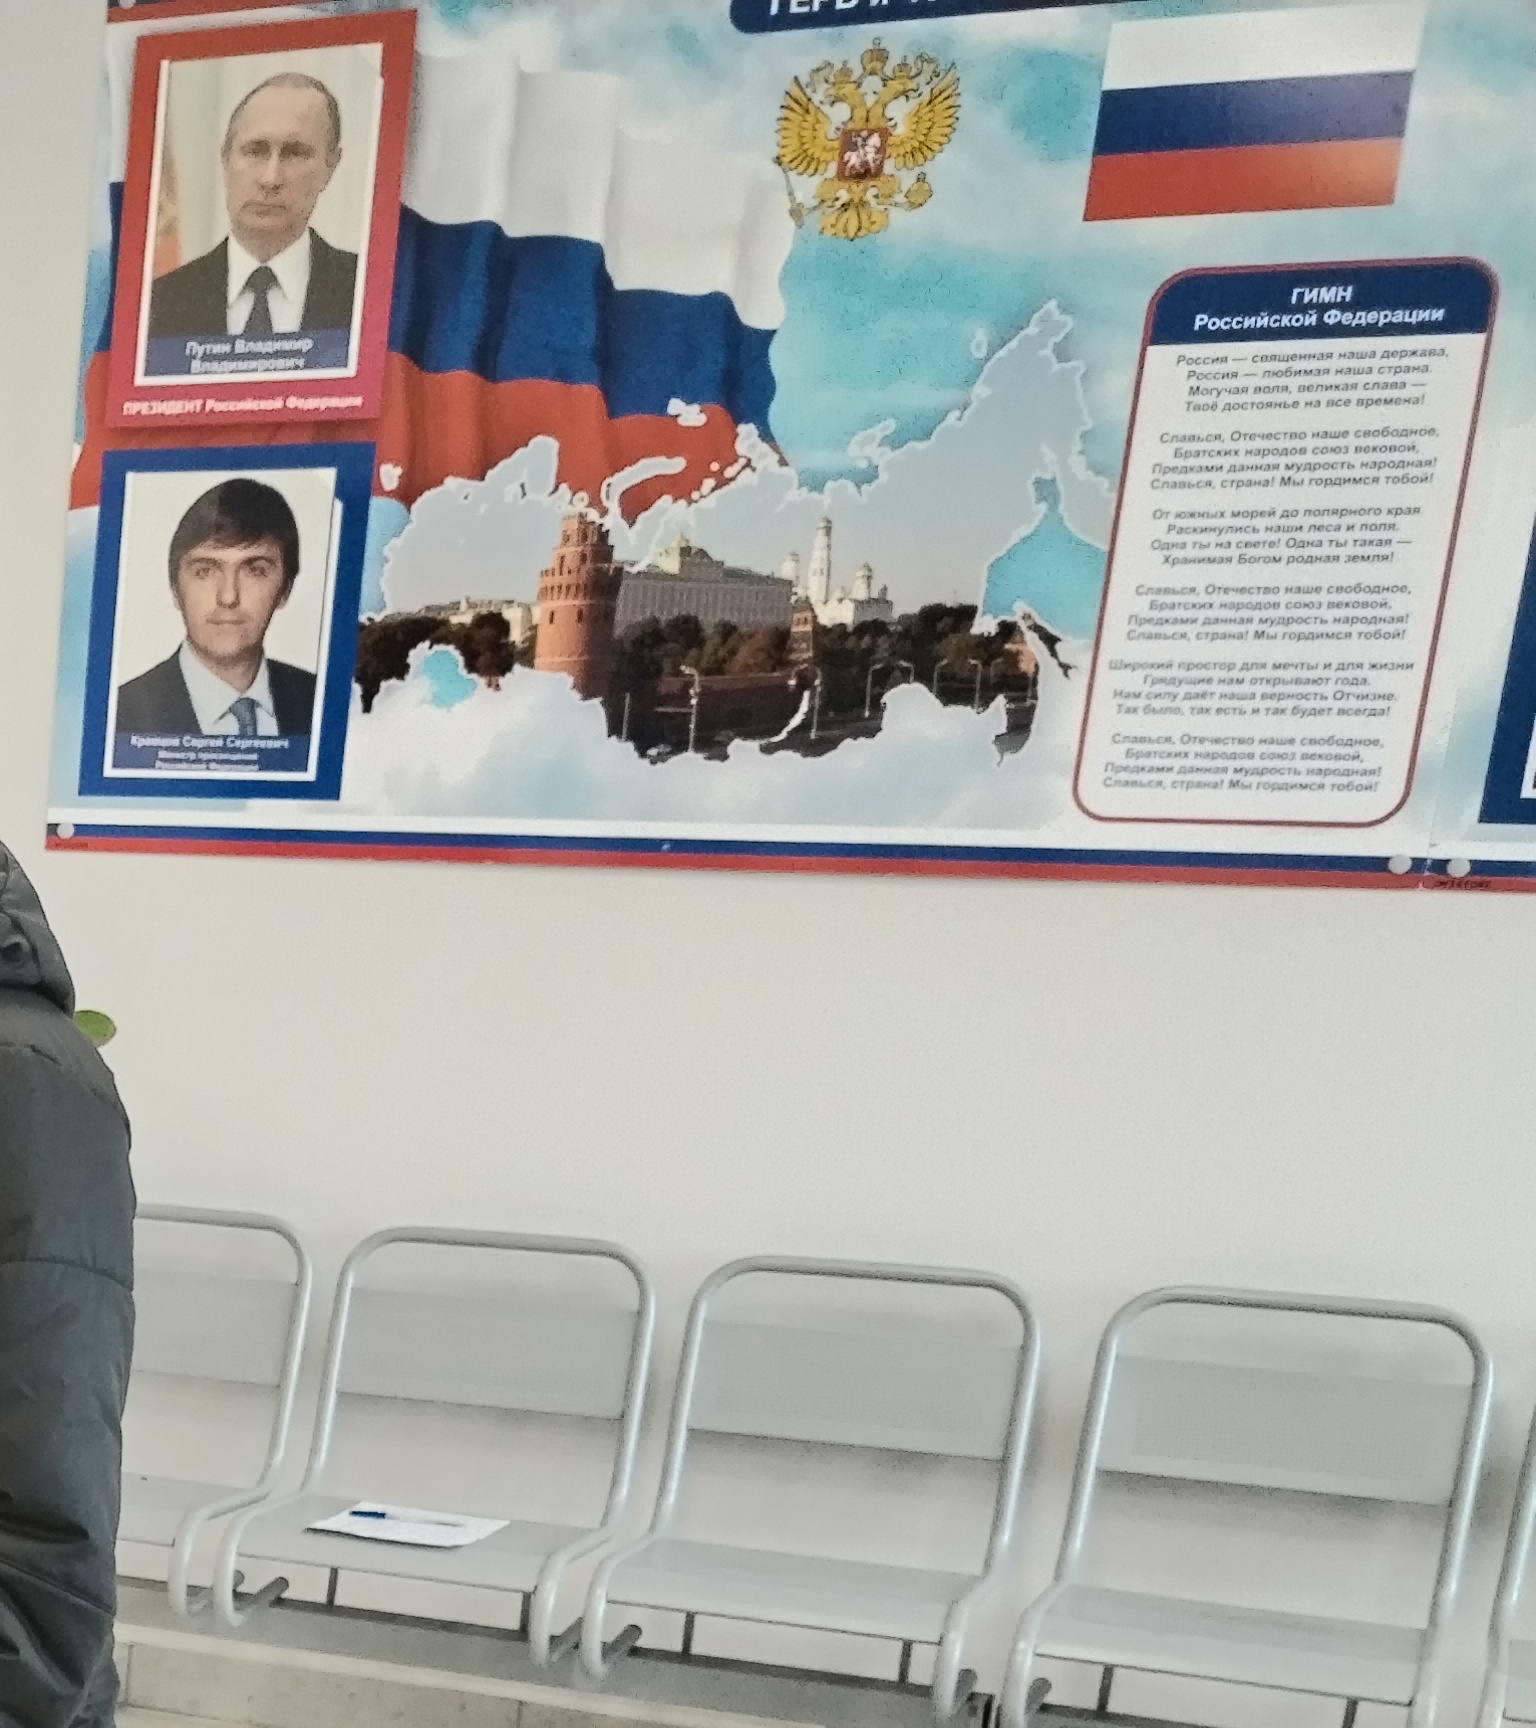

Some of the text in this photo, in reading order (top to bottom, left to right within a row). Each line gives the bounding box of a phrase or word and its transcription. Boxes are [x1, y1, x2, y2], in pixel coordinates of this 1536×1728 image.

[1291, 285, 1354, 305] ГИМН
[1194, 307, 1446, 331] Российской Федерации
[1175, 353, 1228, 365] Россия
[1251, 352, 1333, 365] священная
[1337, 351, 1377, 360] наша
[1186, 368, 1239, 380] Россия
[1261, 366, 1330, 378] любимая
[1334, 366, 1373, 376] наша
[1187, 384, 1249, 398] Могучая
[1297, 383, 1358, 393] великая
[1362, 382, 1406, 391] слава
[123, 394, 364, 415] ПРЕЗИДЕНТ Российской Федерации
[1185, 395, 1425, 412] Твоё достоянье на все времена!
[1229, 429, 1308, 441] Отечество
[1310, 430, 1350, 439] наше
[1173, 445, 1240, 459] Братских
[1244, 445, 1307, 458] народов
[1311, 444, 1350, 454] союз
[1151, 456, 1437, 475] Предками данная мудрость народная!
[1220, 476, 1275, 489] страна!
[1278, 475, 1305, 486] Мы
[1307, 476, 1380, 488] гордимся
[1385, 473, 1433, 484] тобой!
[1151, 506, 1421, 520] От южных морей до полярного края
[1166, 522, 1260, 536] Раскинулись
[1264, 524, 1303, 532] наши
[1307, 523, 1342, 532] леса
[1149, 537, 1393, 551] Одна ты на свете! Одна ты такая
[1162, 552, 1394, 566] Хранимая Богом родная земля!
